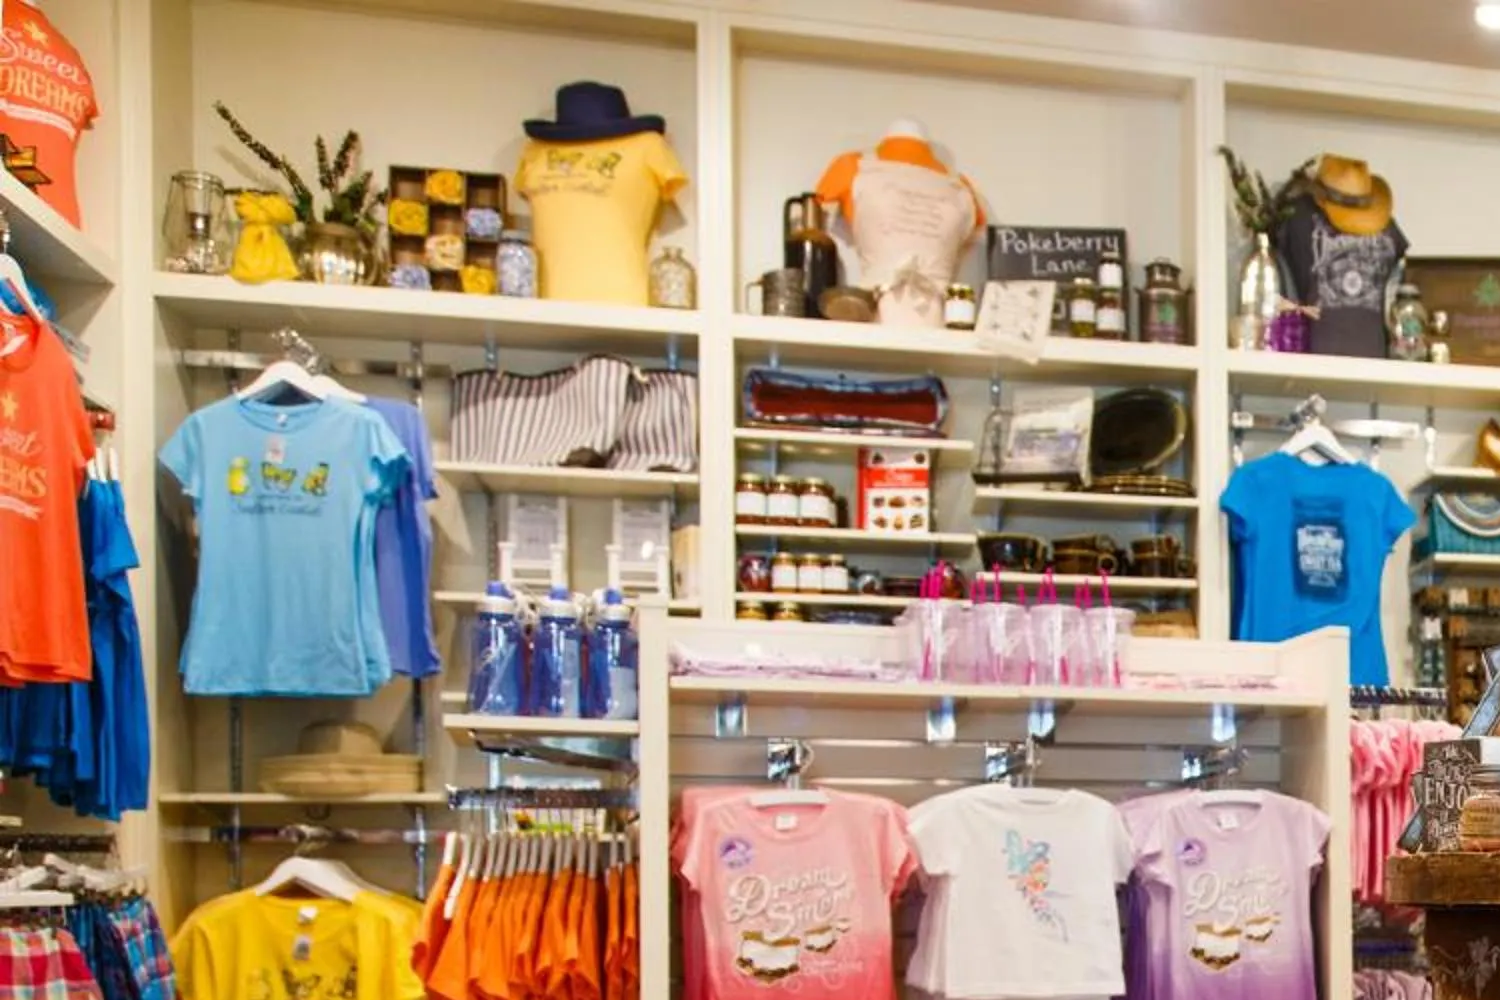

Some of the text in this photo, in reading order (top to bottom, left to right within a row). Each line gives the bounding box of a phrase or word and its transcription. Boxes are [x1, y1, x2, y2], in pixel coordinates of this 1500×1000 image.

[997, 228, 1120, 255] Pokeberry
[1031, 254, 1088, 277] Lane
[1424, 777, 1469, 810] ENJO
